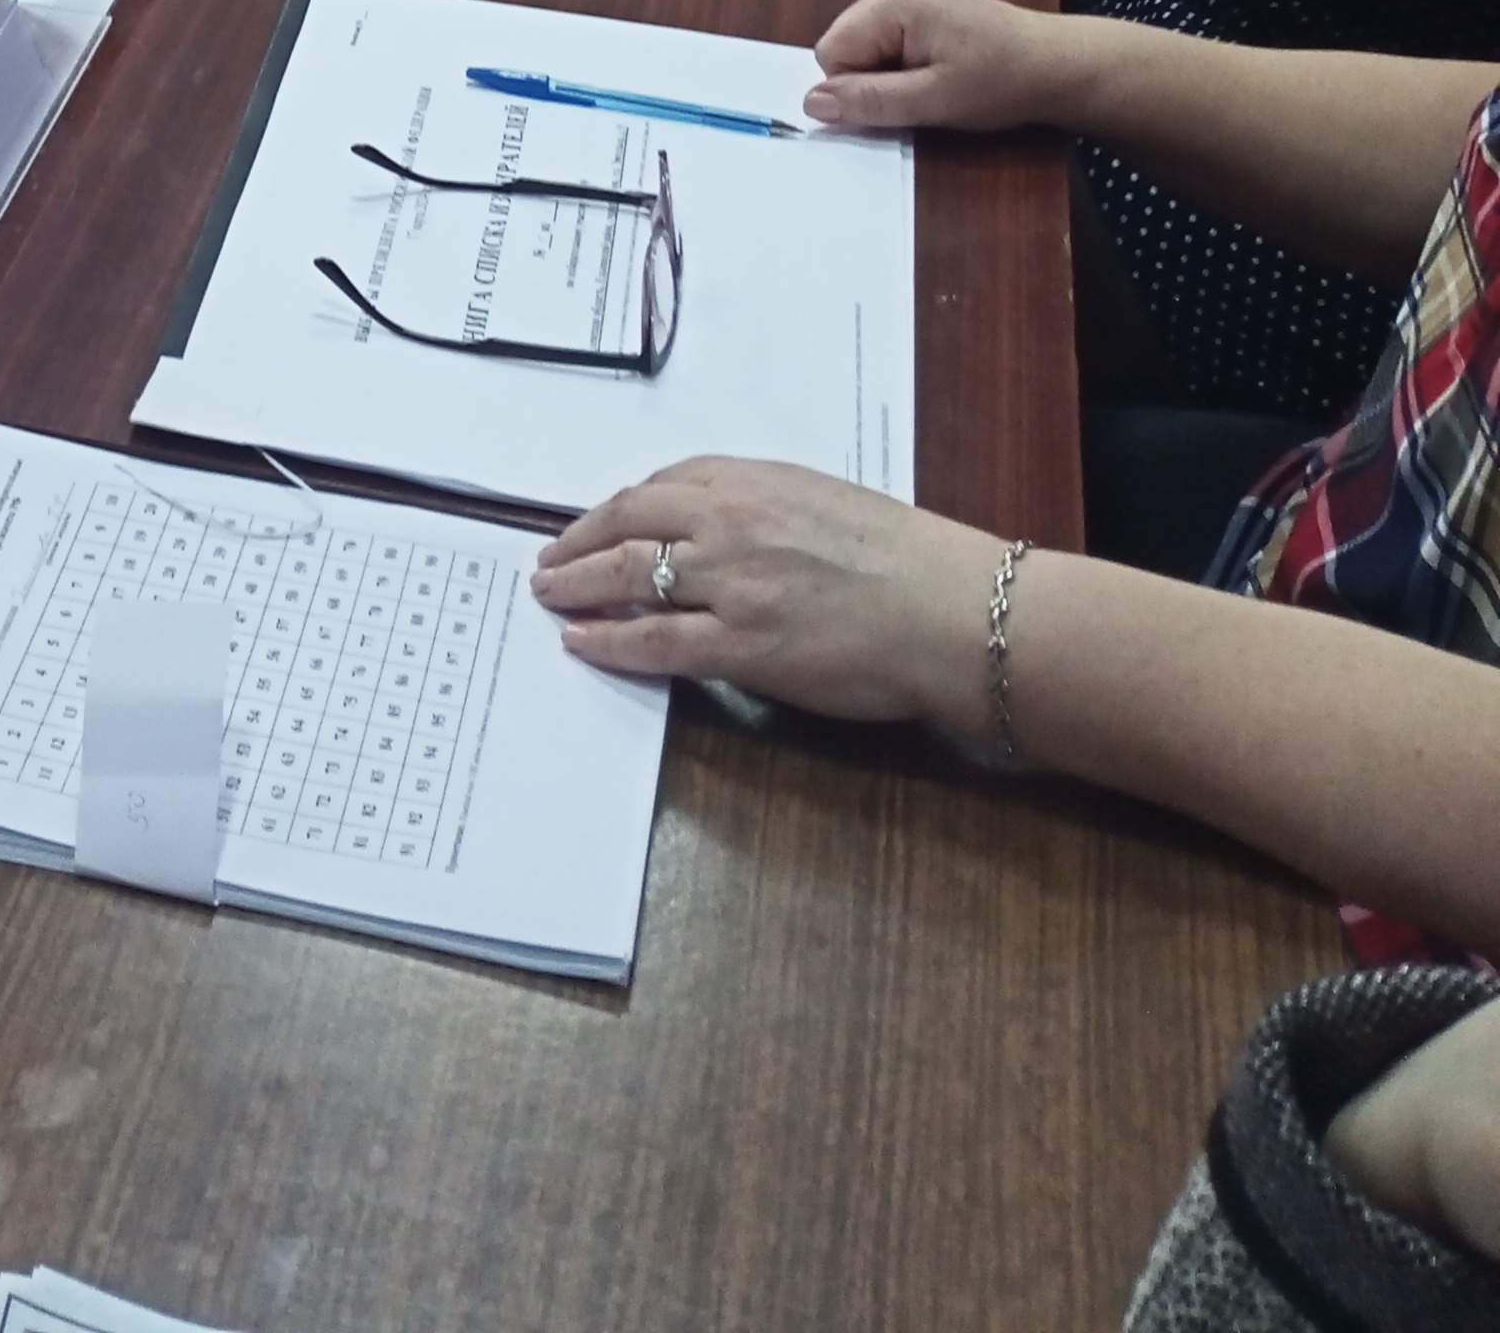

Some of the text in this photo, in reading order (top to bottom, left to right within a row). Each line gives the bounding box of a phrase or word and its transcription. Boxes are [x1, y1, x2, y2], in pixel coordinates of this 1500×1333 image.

[460, 104, 530, 346] НИГА СПИСКА ИЗИРАТЕЛЕЙ
